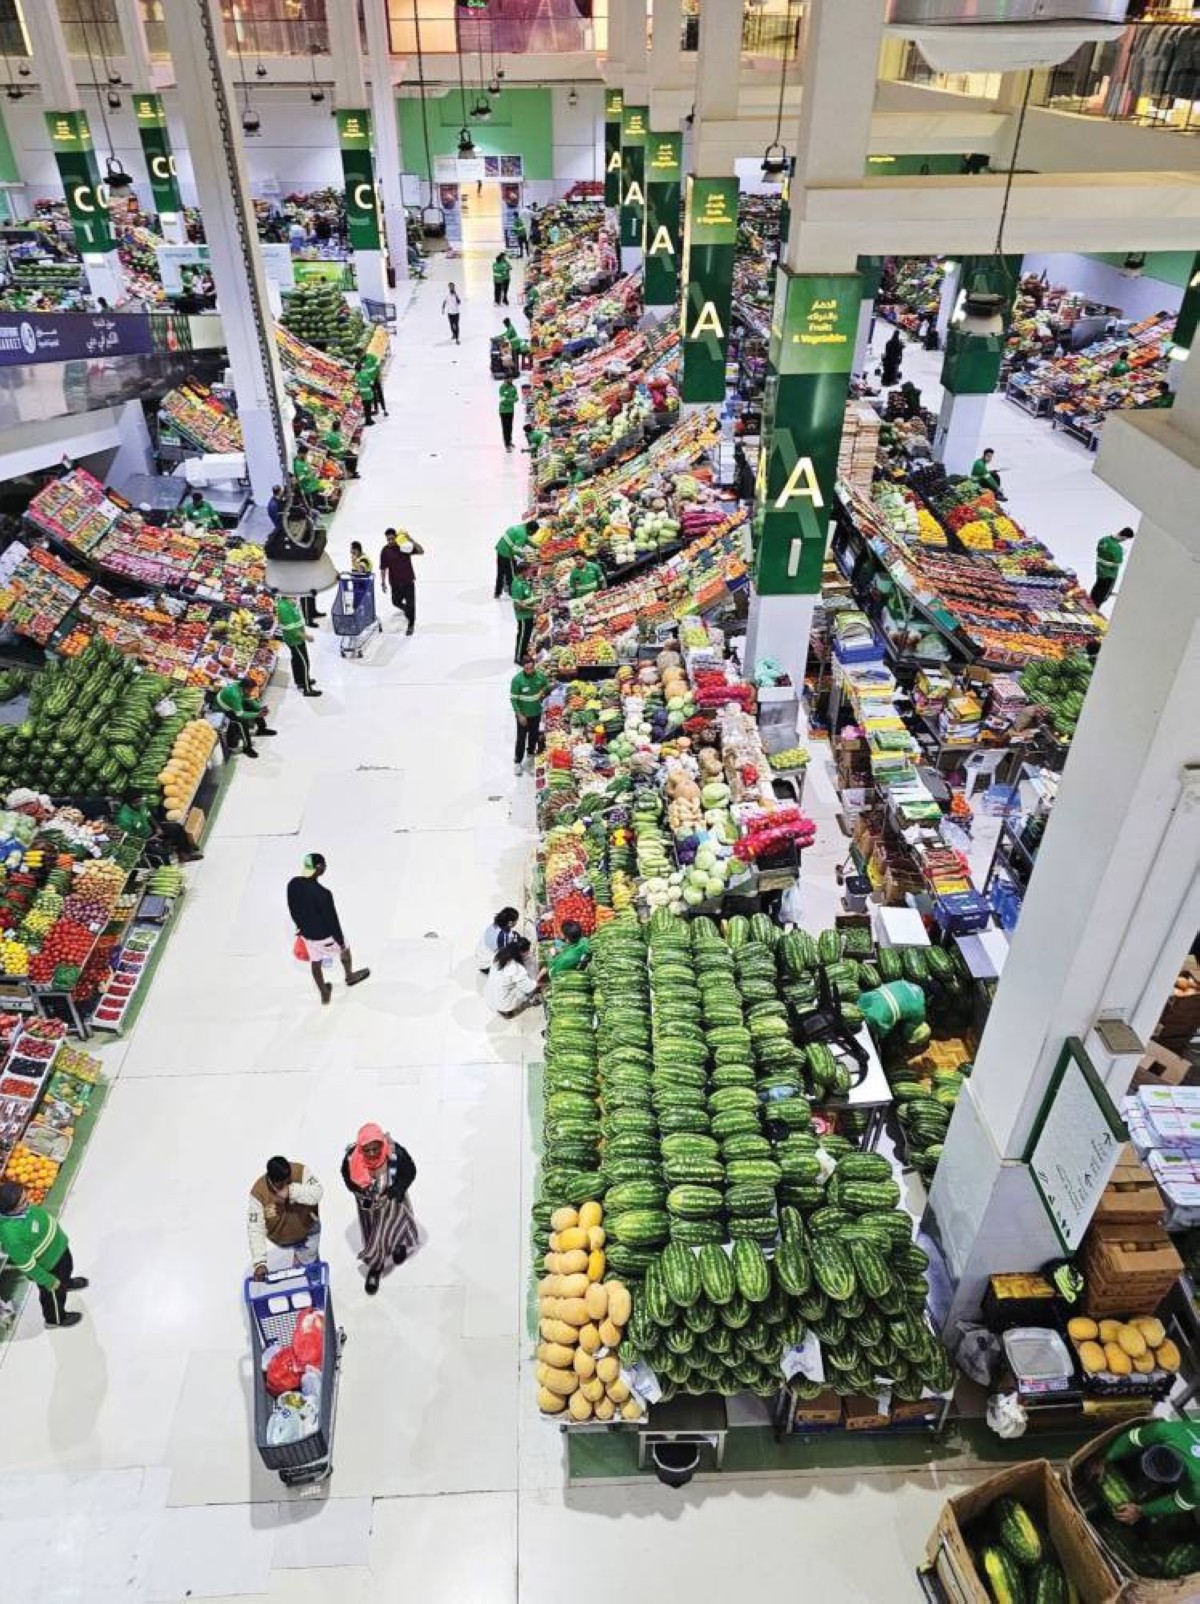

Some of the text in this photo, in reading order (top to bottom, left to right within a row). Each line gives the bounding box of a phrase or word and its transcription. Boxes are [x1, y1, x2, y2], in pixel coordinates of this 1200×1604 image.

[152, 157, 170, 178] C
[607, 151, 622, 173] A
[74, 186, 95, 212] C
[354, 184, 374, 210] C
[624, 181, 645, 205] A
[650, 225, 675, 254] A
[691, 301, 724, 339] A
[774, 456, 825, 508] A
